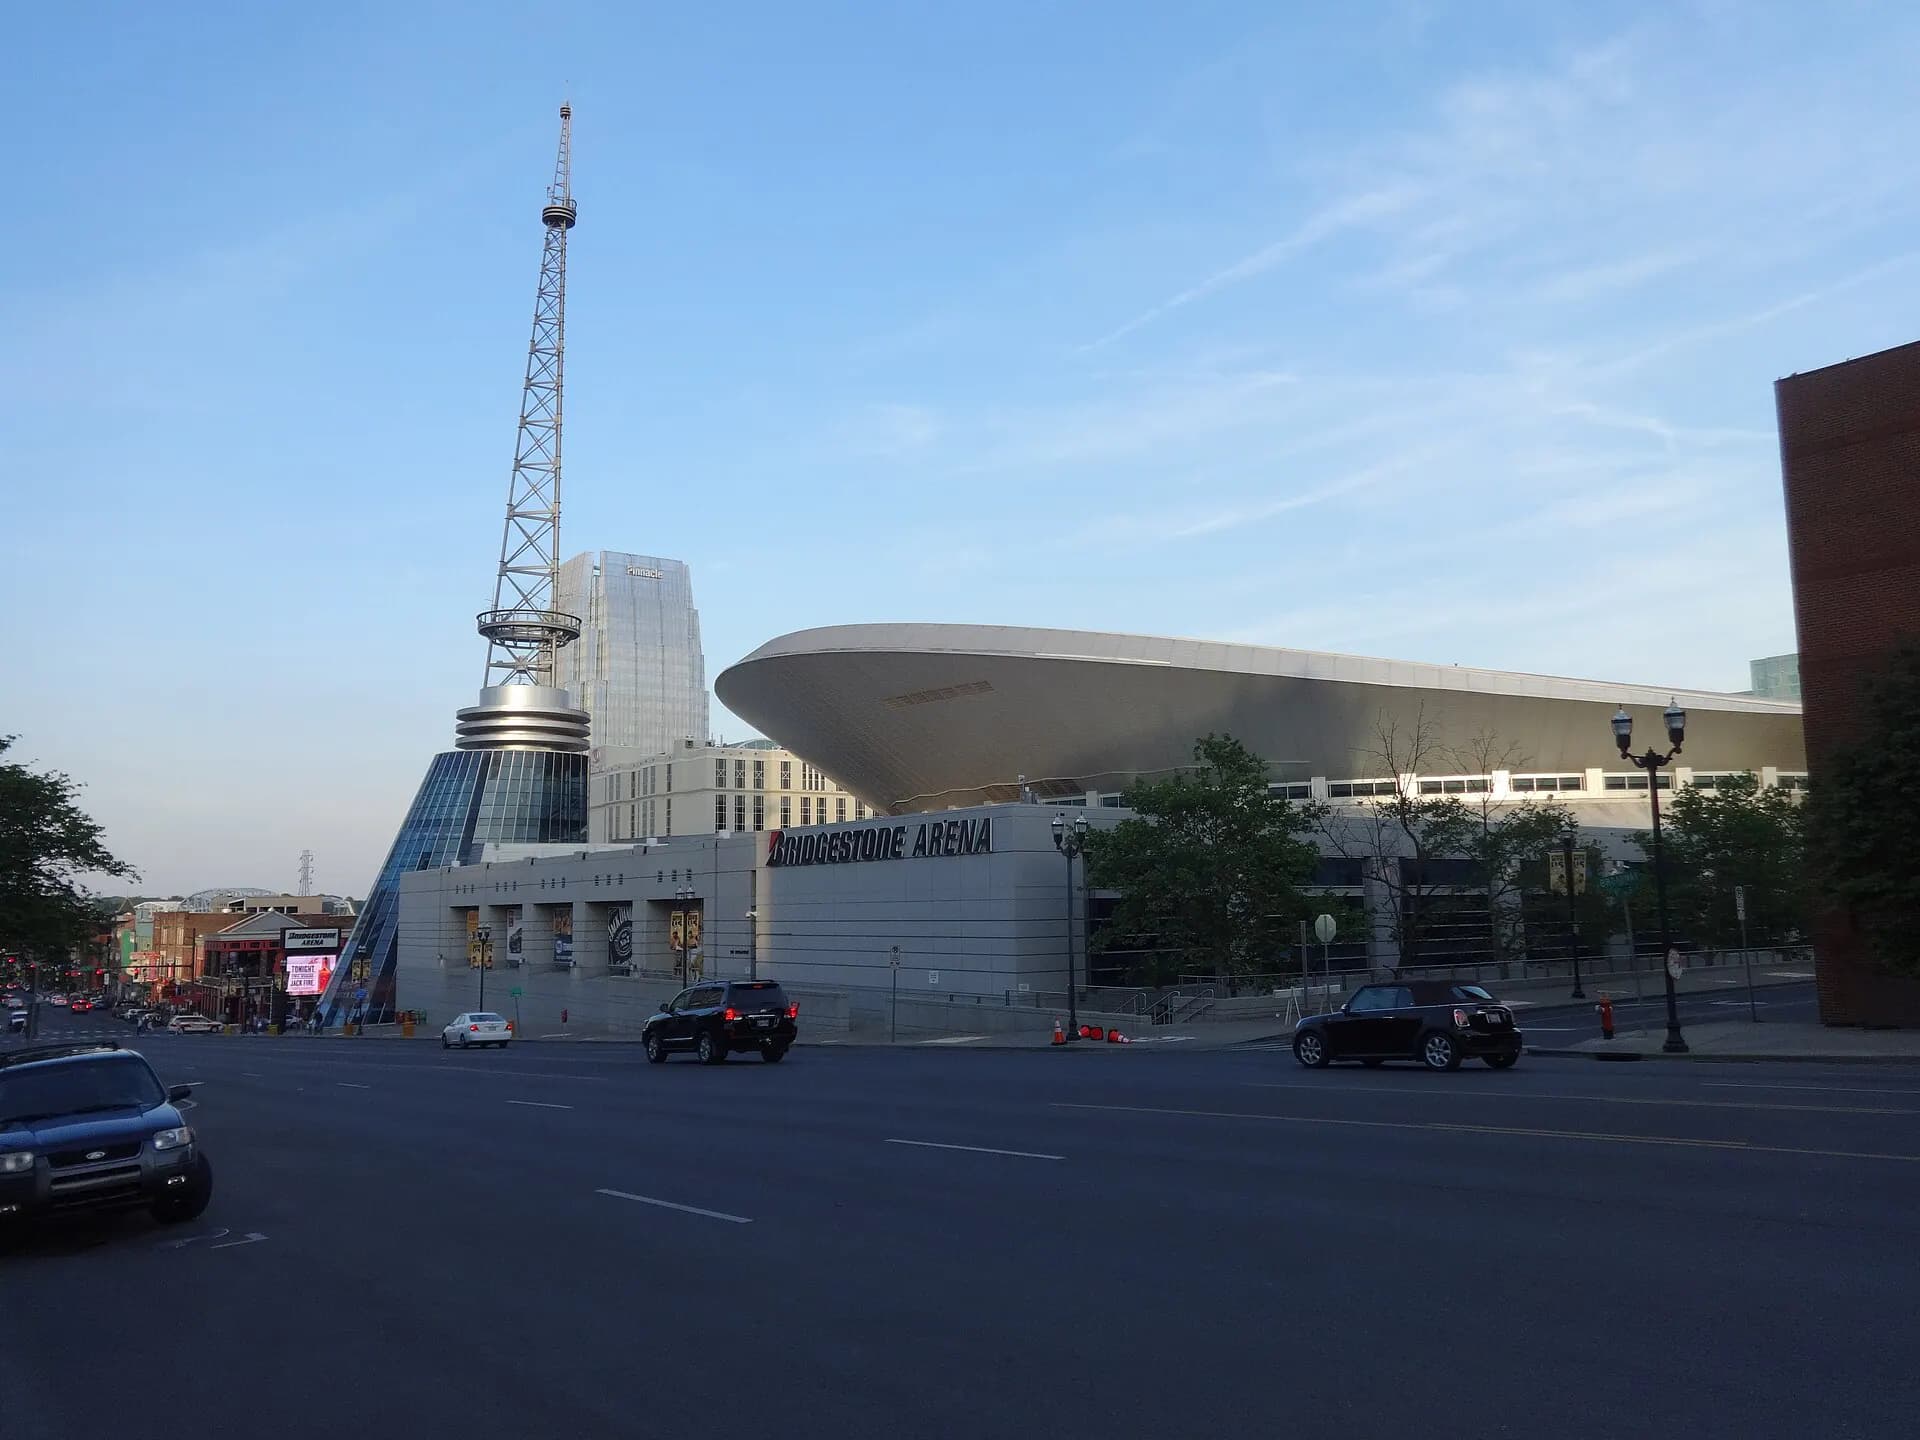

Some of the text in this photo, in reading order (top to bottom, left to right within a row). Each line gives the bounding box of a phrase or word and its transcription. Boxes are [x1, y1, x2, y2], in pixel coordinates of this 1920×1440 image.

[627, 565, 665, 579] Pinnacle
[767, 818, 993, 867] BRIDGESTONE ARENA
[291, 965, 315, 973] TONIGHT
